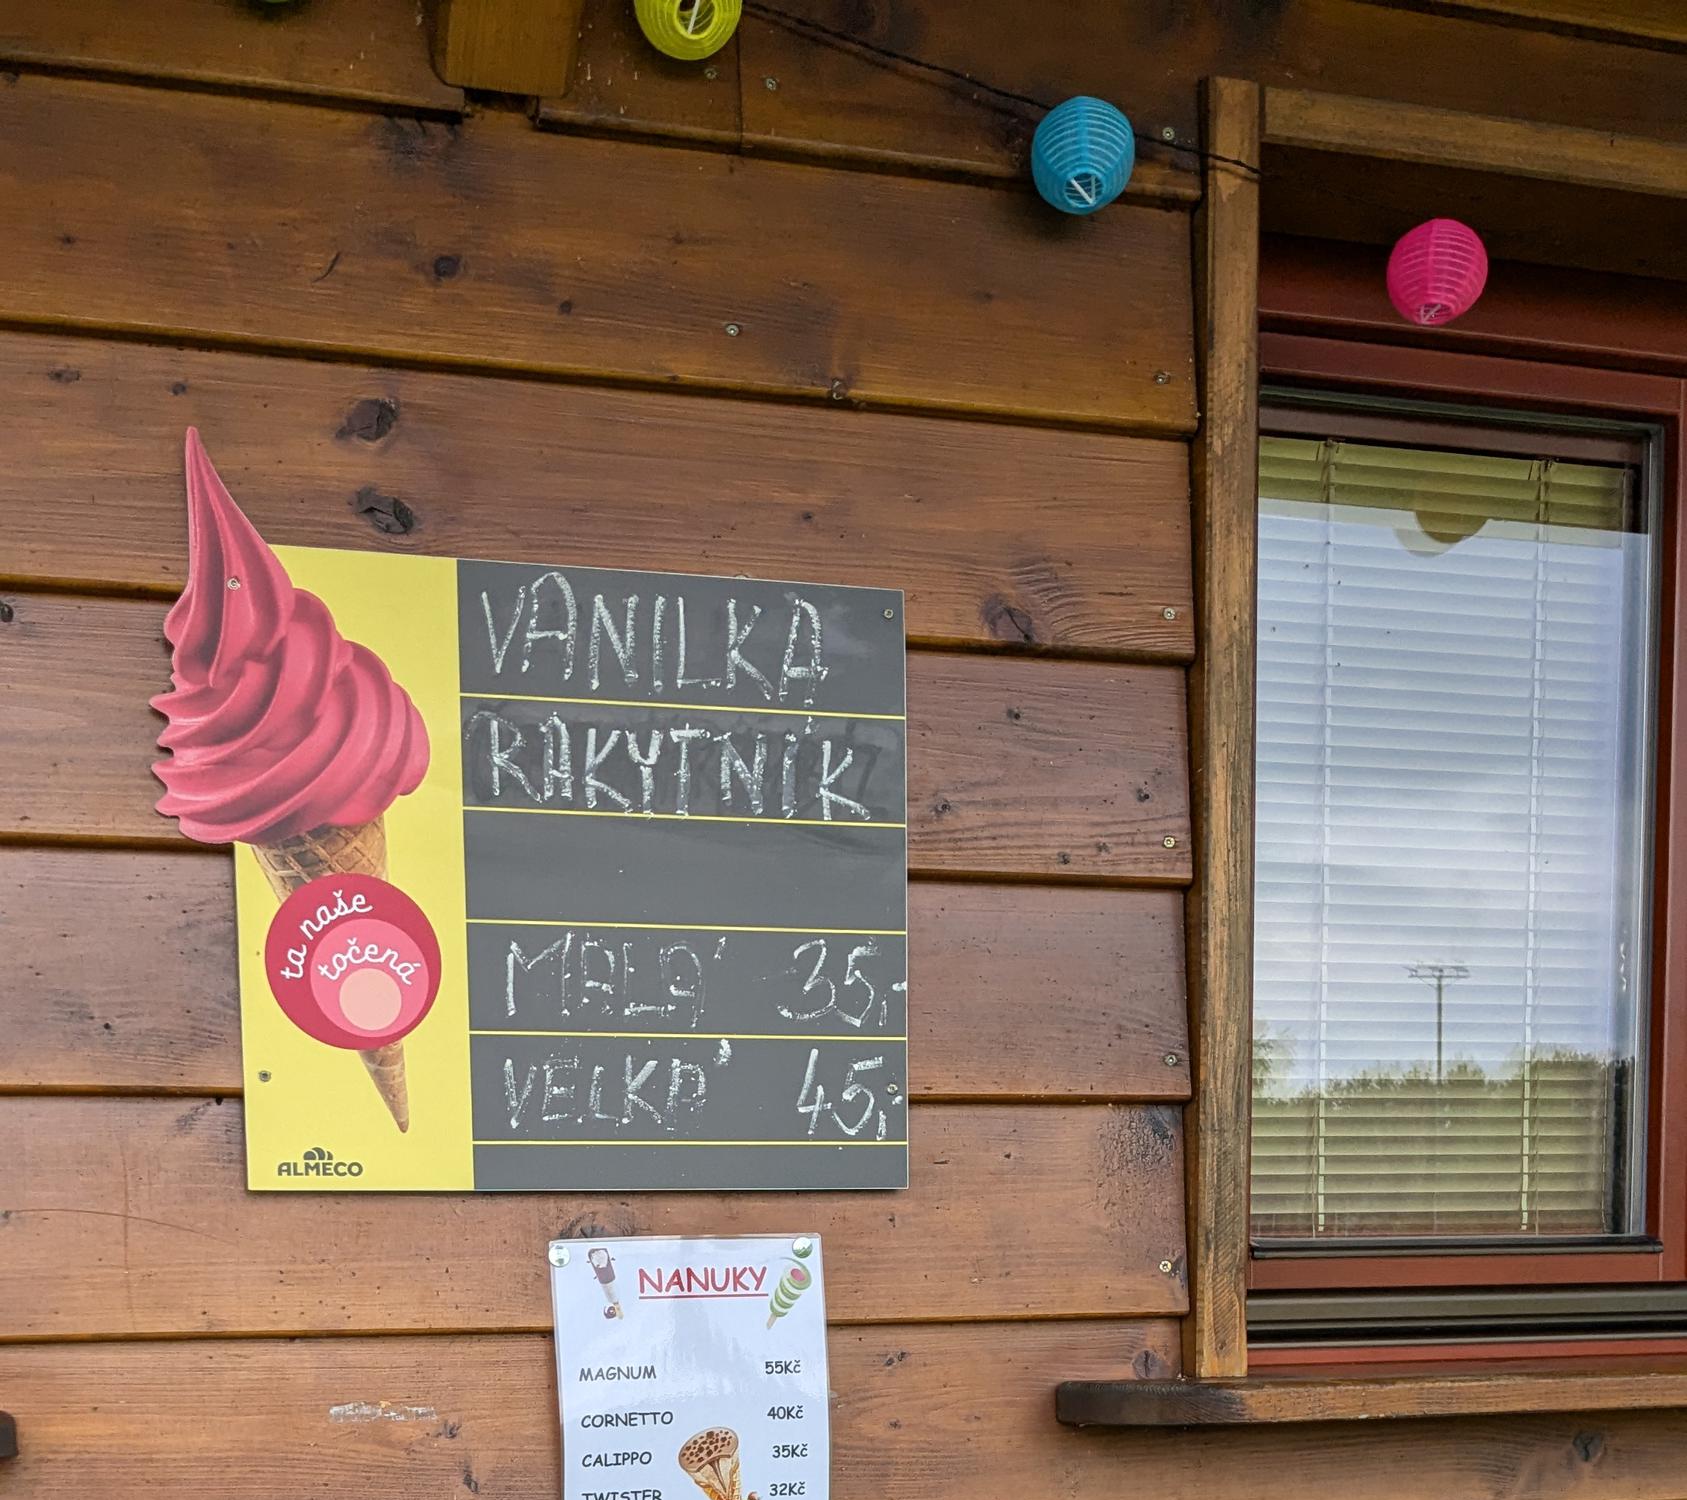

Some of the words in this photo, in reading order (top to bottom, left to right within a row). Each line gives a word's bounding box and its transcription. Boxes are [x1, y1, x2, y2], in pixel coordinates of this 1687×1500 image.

[481, 572, 830, 704] VANILKA
[280, 943, 308, 980] ta
[299, 889, 374, 941] naše
[317, 937, 422, 986] točená
[277, 1161, 364, 1177] ALMECO
[638, 1265, 768, 1293] NANUKY
[579, 1364, 657, 1382] MAGNUM
[765, 1359, 802, 1374] 55Kč
[581, 1411, 673, 1428] CORNETTO
[767, 1405, 804, 1420] 40Kč
[581, 1451, 652, 1467] CALIPPO
[772, 1443, 808, 1458] 35Kč
[769, 1481, 806, 1496] 32Kč
